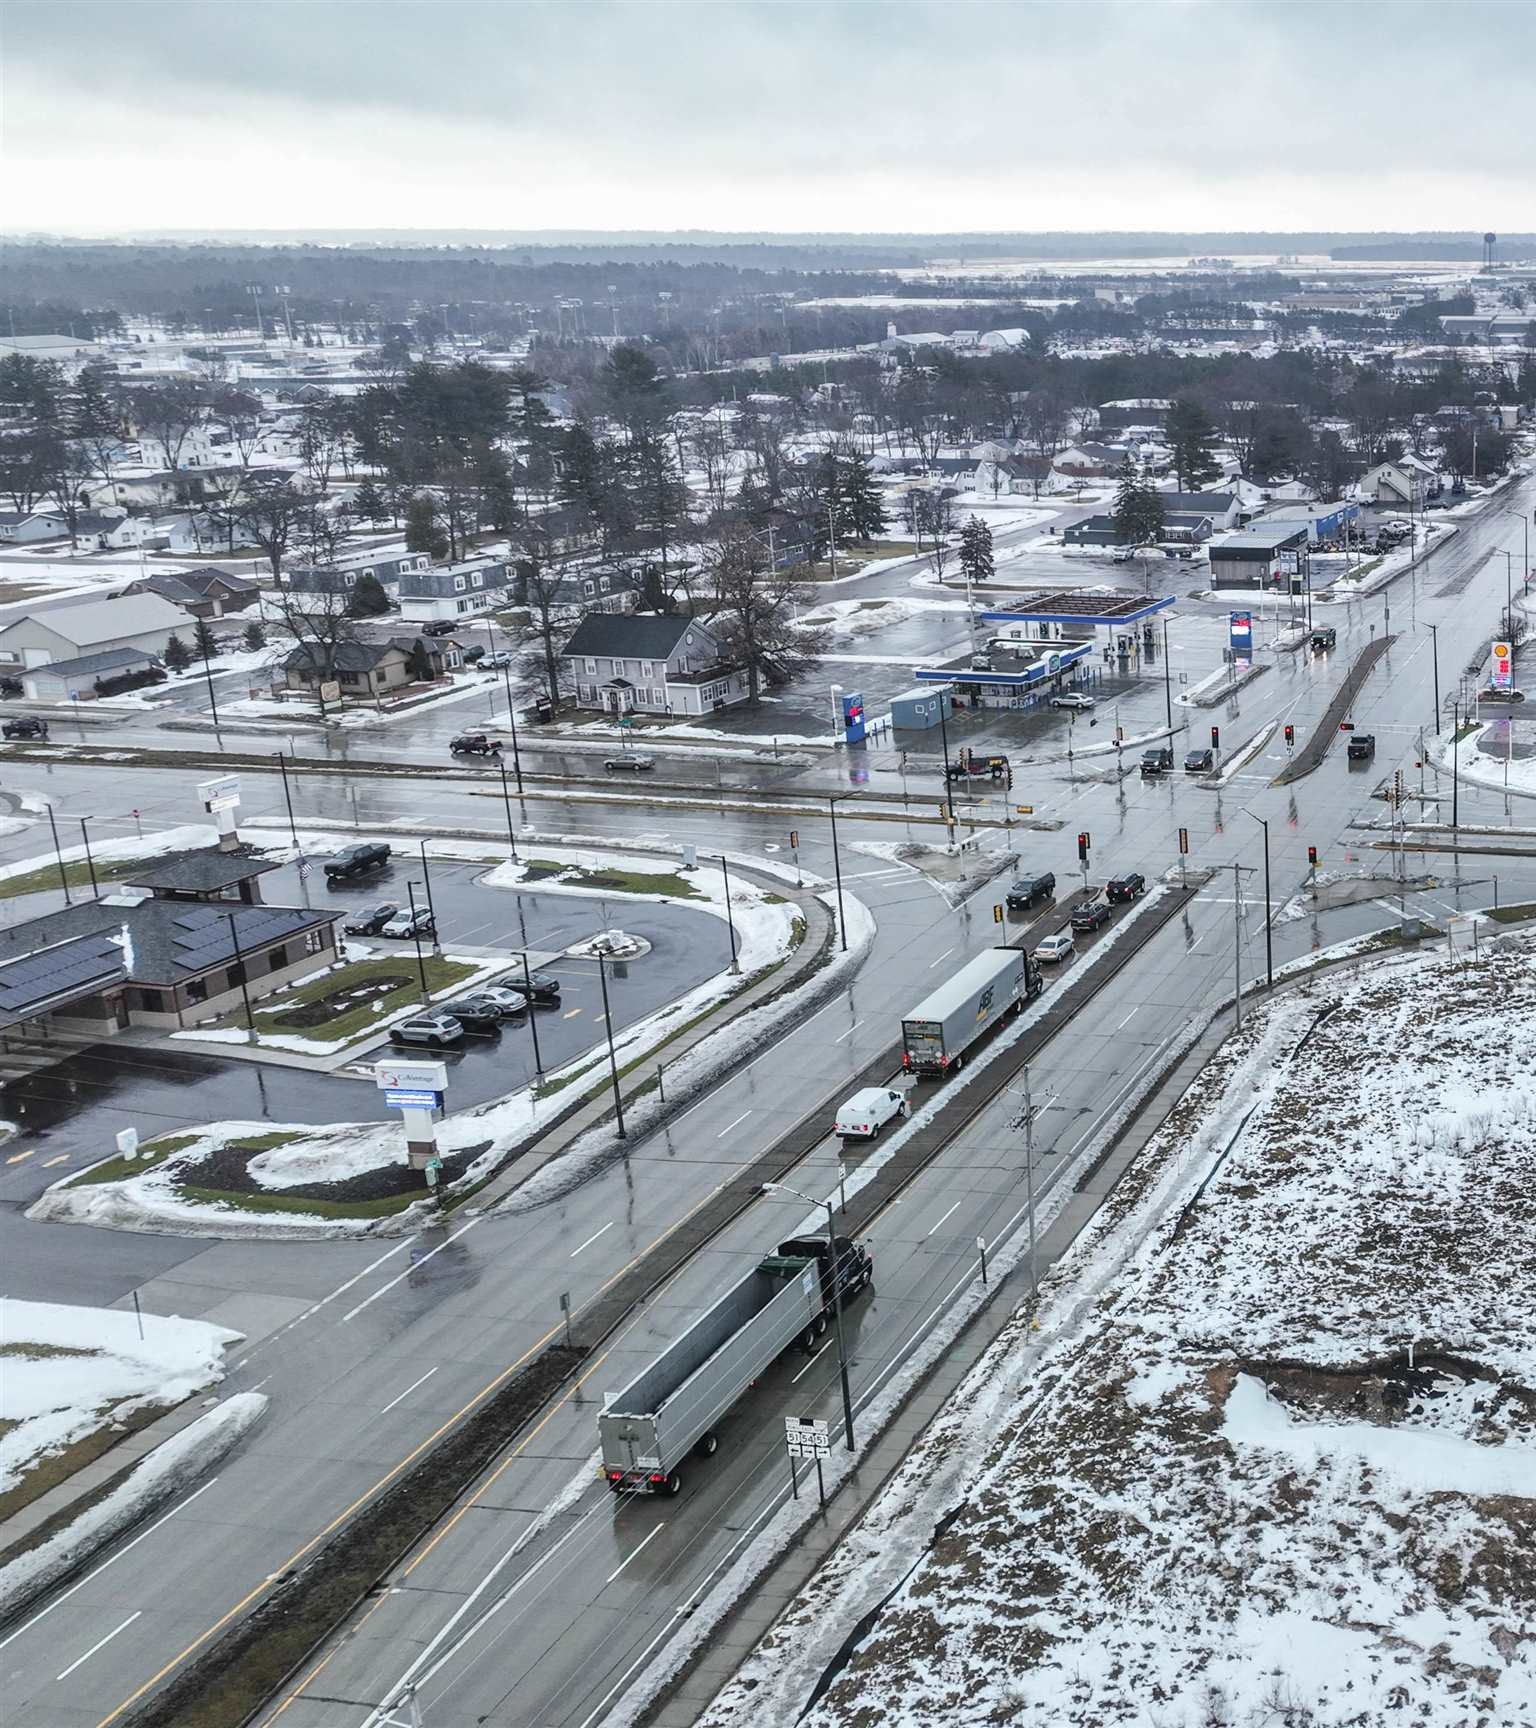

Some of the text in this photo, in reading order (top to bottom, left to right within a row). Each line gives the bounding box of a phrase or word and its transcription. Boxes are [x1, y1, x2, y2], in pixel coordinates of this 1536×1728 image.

[788, 1432, 799, 1442] 51
[802, 1434, 814, 1444] 54
[816, 1436, 827, 1445] 51
